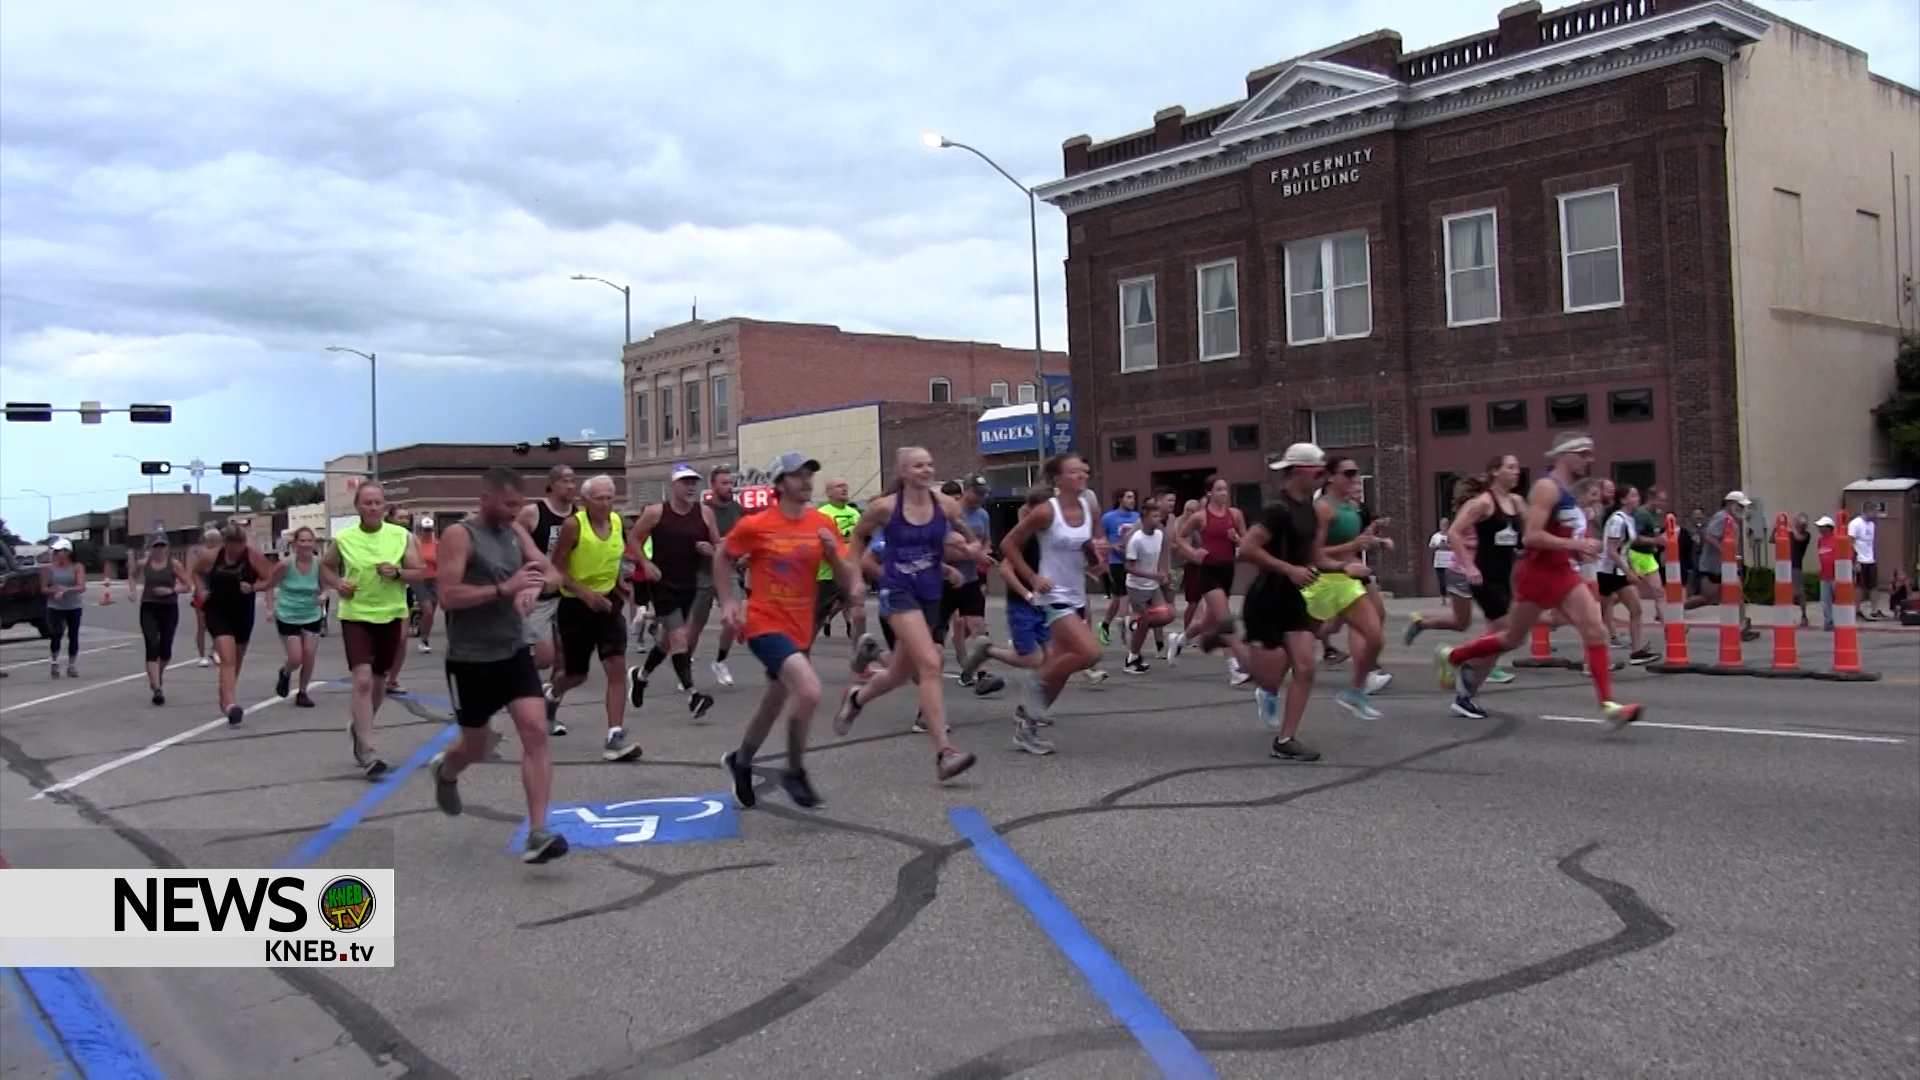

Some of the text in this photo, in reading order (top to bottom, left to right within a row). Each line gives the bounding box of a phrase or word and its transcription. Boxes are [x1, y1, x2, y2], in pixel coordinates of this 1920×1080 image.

[1270, 148, 1372, 184] FRATERNITY
[1283, 169, 1359, 197] BUILDING
[981, 426, 1034, 442] BAGELS
